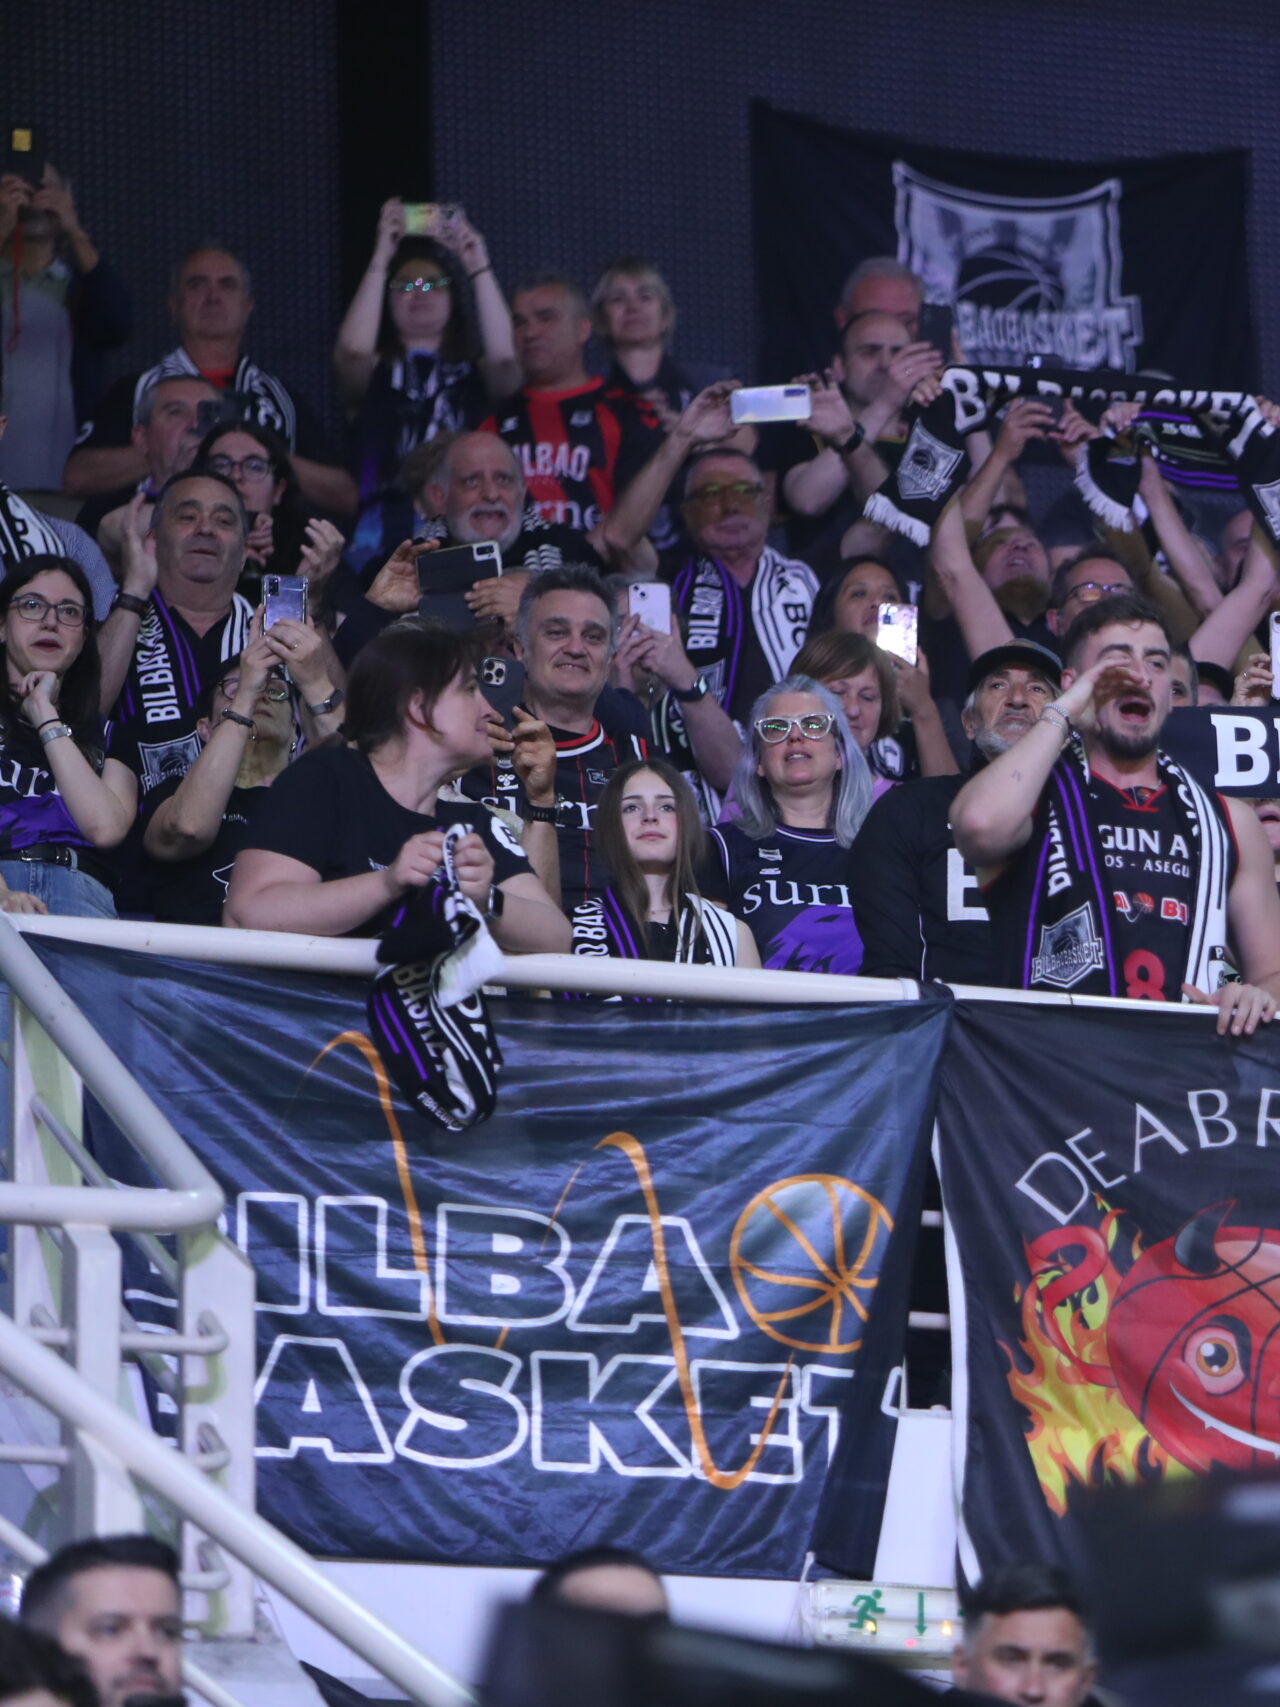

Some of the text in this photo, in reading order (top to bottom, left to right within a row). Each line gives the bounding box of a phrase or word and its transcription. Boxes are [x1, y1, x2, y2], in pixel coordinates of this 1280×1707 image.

[512, 441, 590, 482] LBAO
[1098, 825, 1160, 855] GUN
[1143, 861, 1190, 878] ASEGU
[254, 1334, 856, 1484] ASKE
